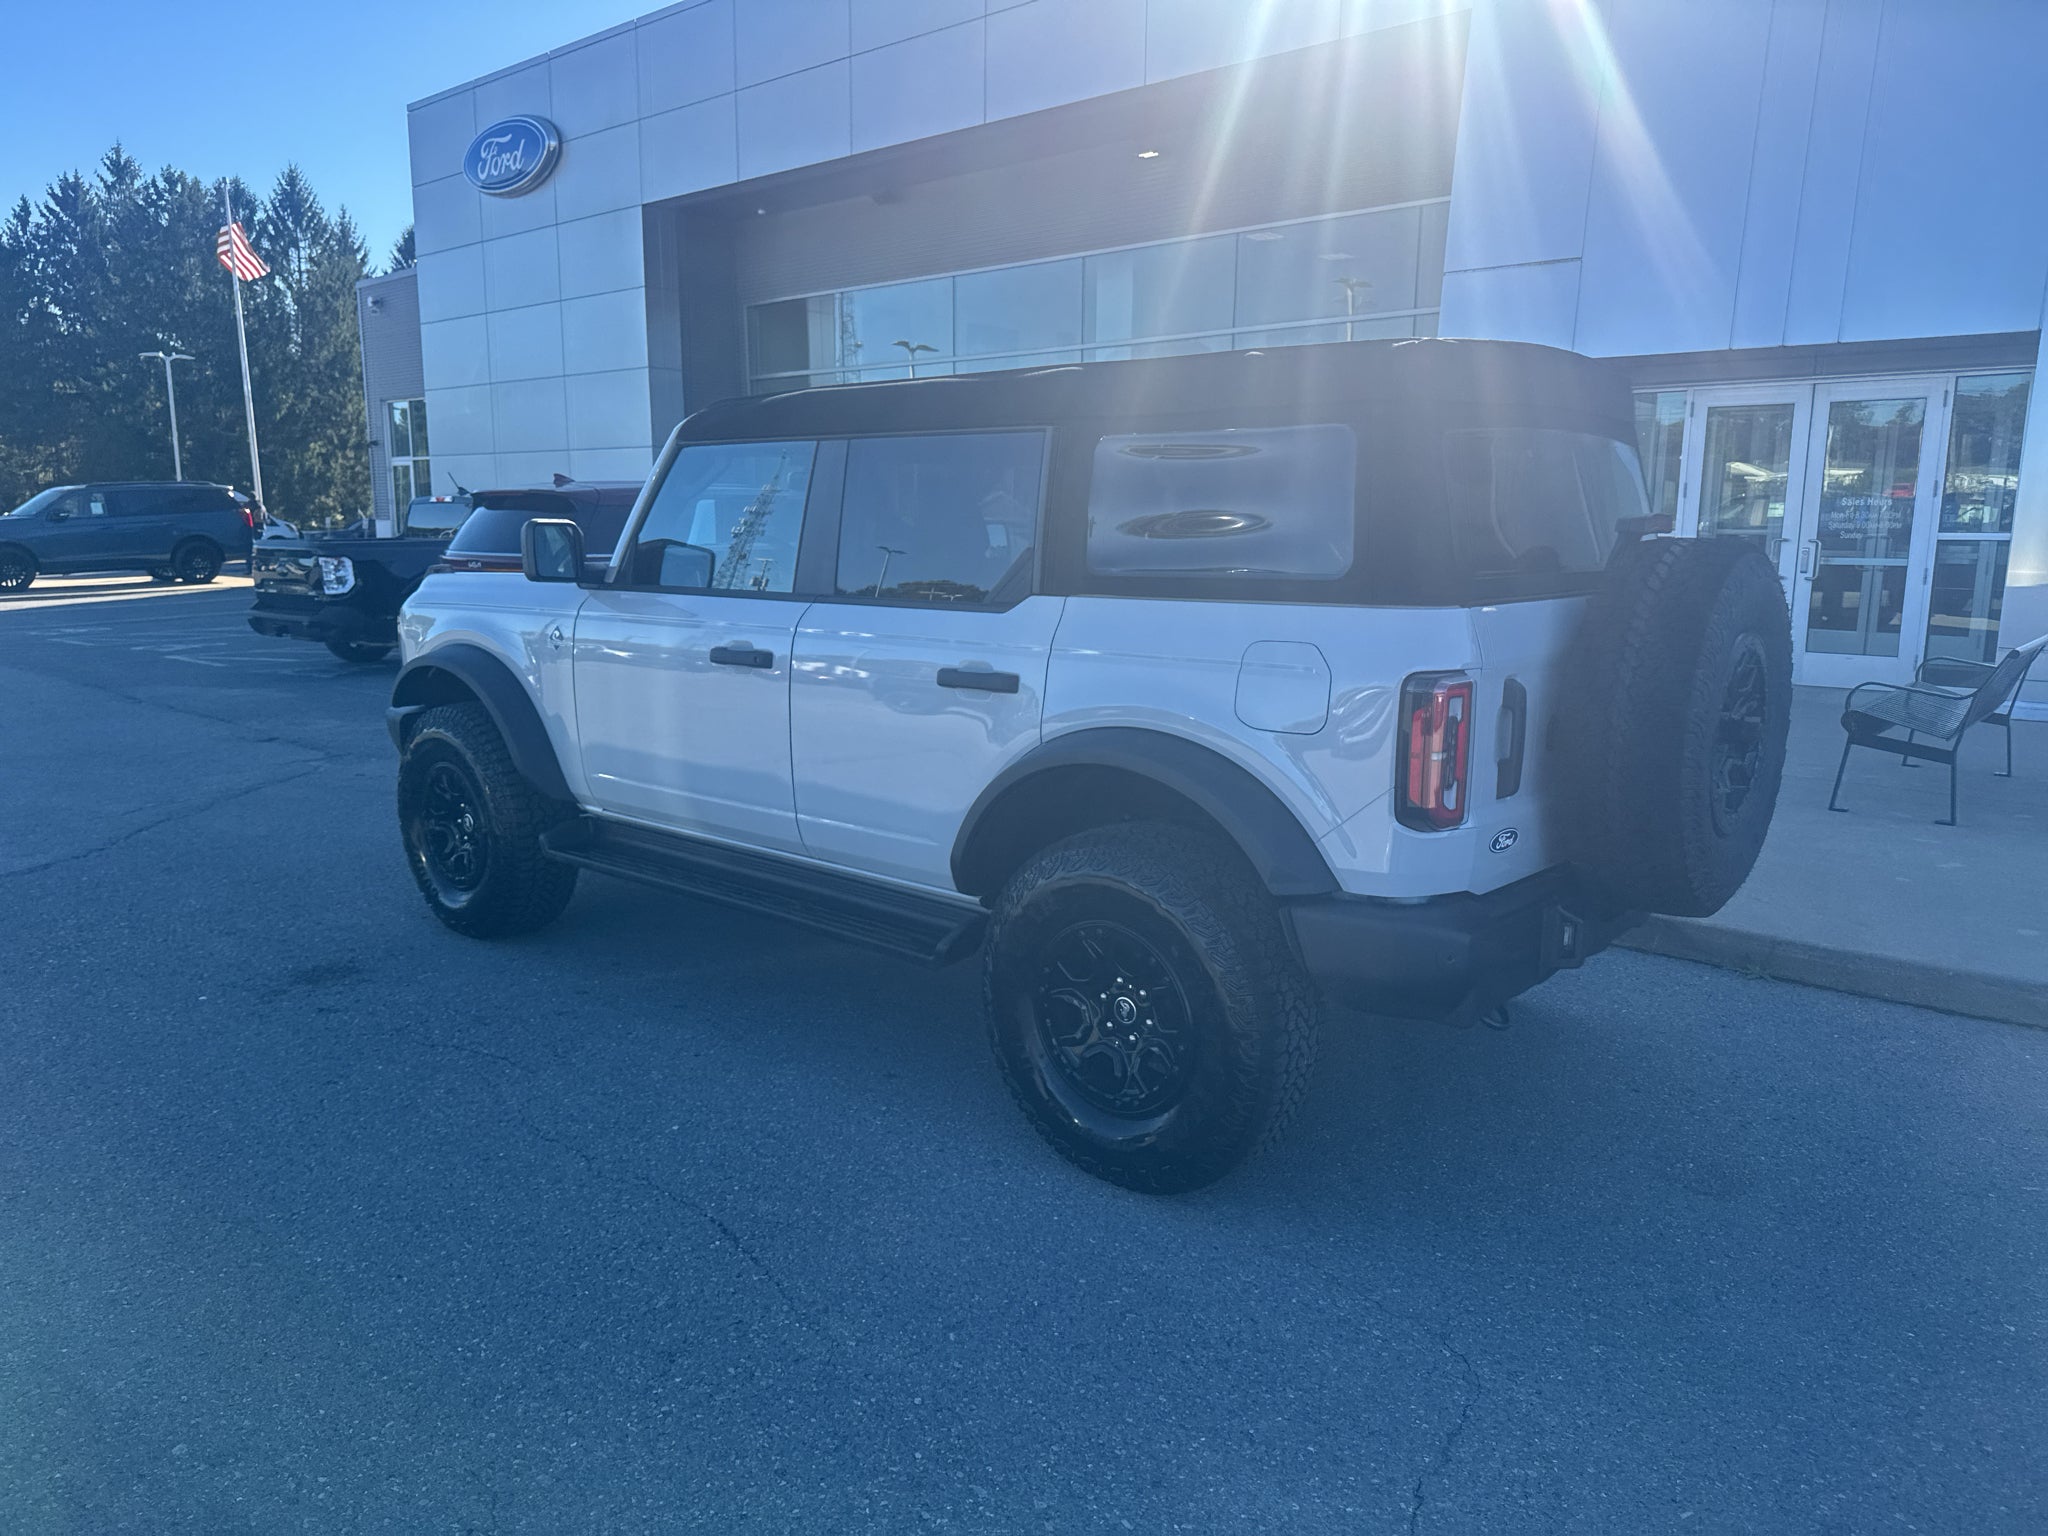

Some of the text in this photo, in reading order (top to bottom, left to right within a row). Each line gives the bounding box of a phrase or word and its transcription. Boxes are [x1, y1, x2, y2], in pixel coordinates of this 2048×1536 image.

[477, 133, 526, 180] Ford
[1841, 497, 1893, 506] Sales Hours
[1496, 833, 1515, 849] Ford
